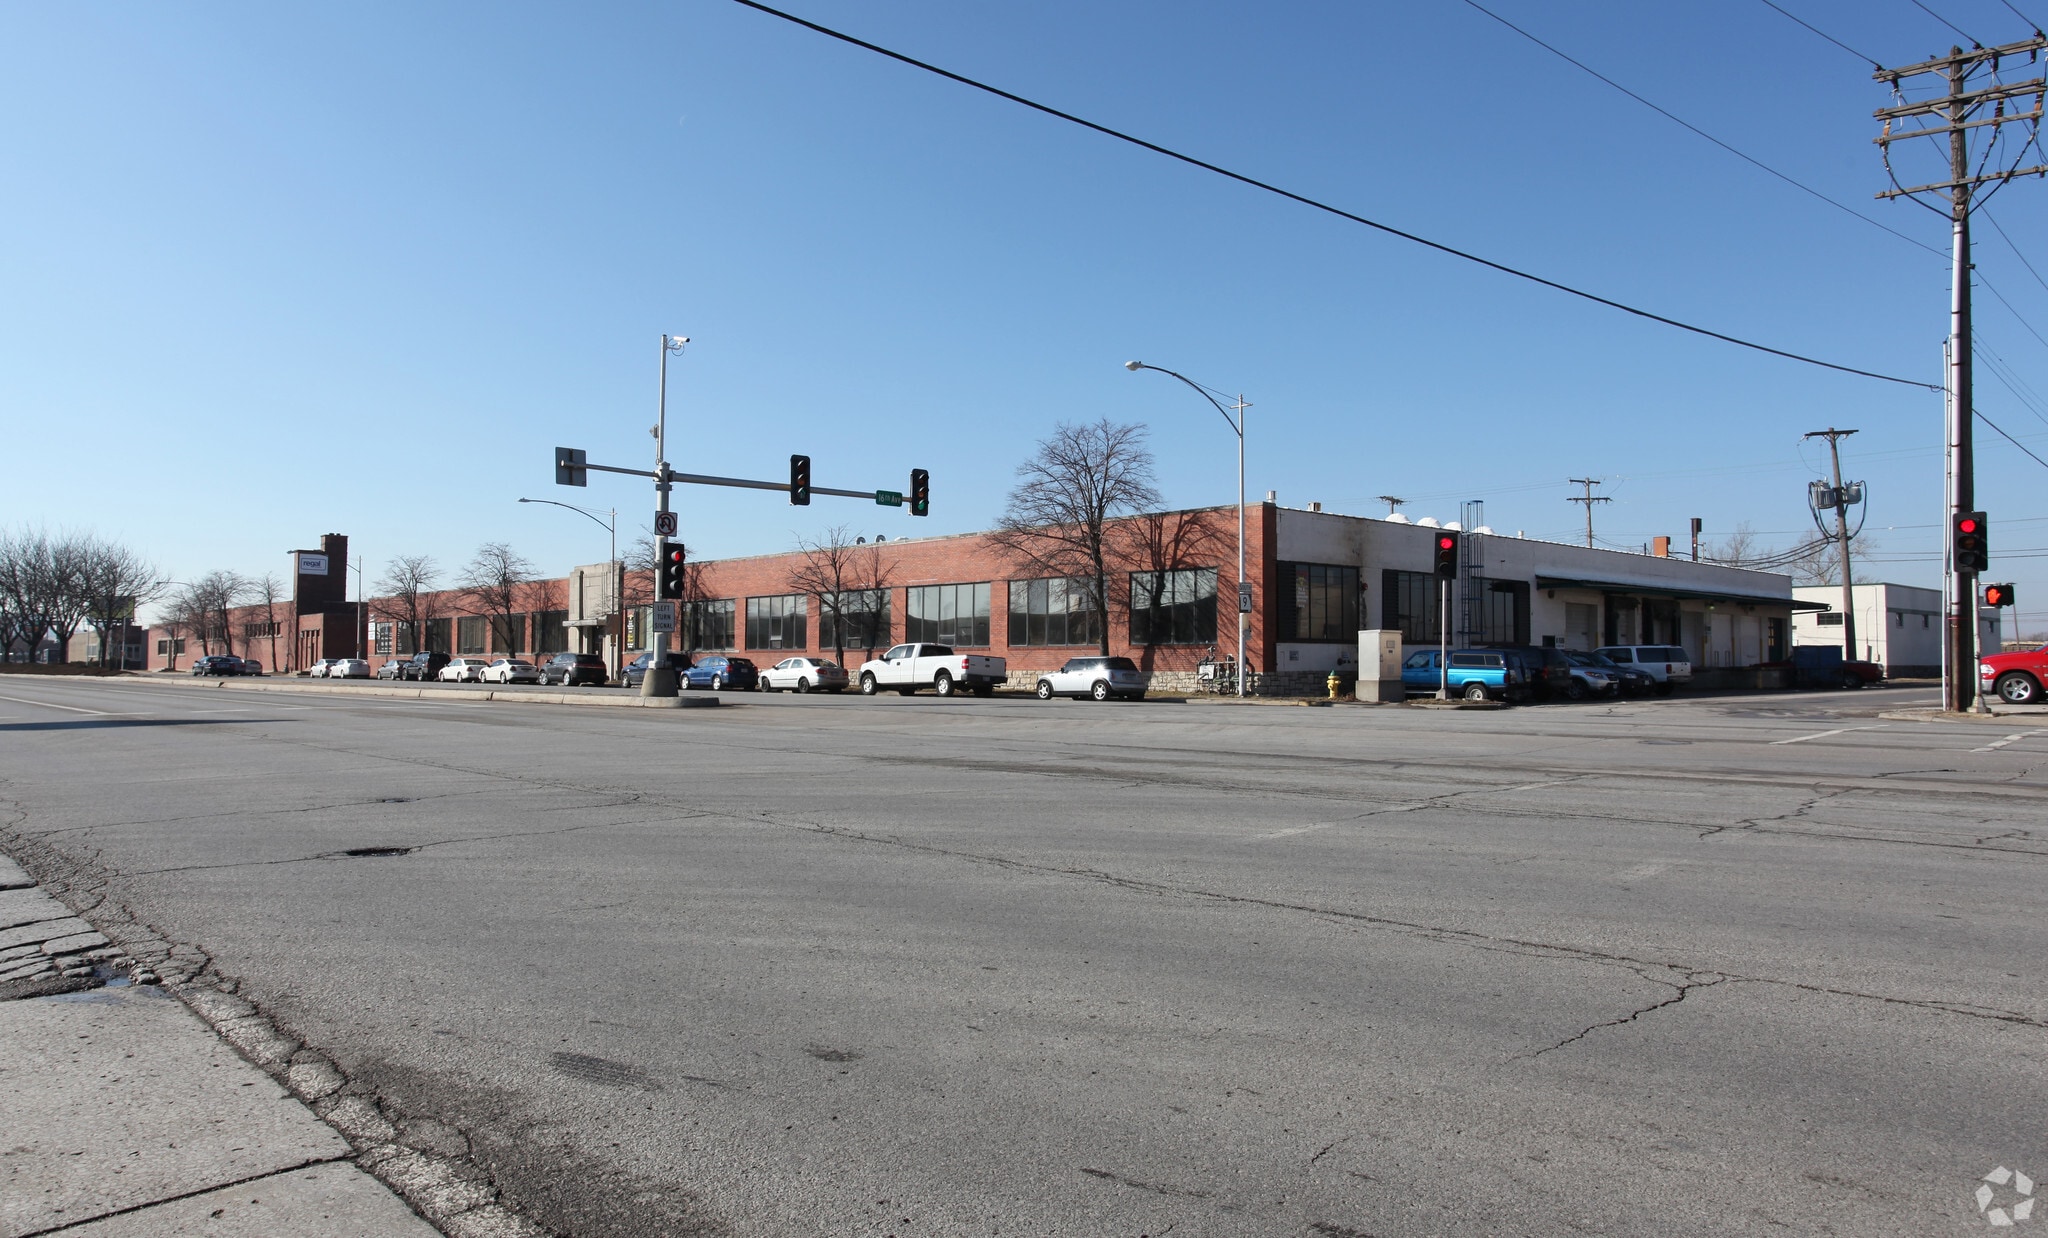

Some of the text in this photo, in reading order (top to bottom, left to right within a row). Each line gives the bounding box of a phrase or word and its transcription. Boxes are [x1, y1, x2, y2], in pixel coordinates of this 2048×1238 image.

[303, 560, 321, 568] regal
[1242, 596, 1248, 608] 9
[657, 613, 672, 621] TURN
[654, 622, 673, 630] SIGNAL
